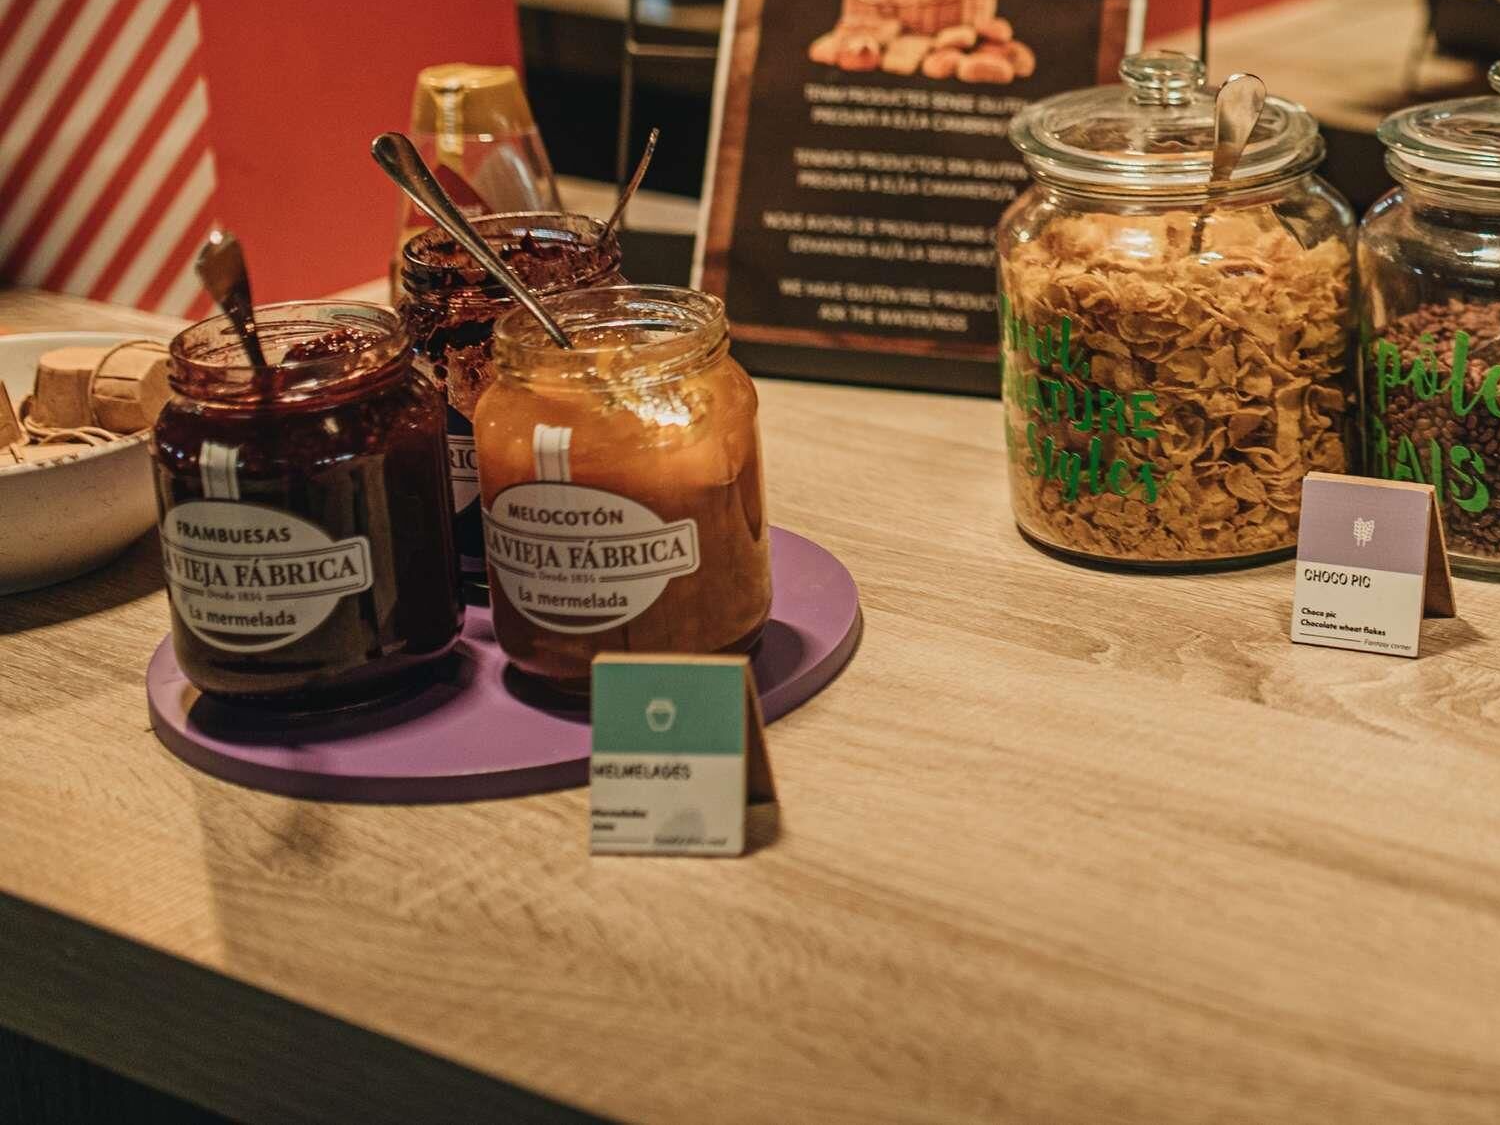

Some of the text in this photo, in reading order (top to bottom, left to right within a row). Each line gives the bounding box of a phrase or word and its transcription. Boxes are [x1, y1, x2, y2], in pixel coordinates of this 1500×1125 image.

[508, 503, 624, 527] MELOCOTÓN
[175, 520, 292, 545] FRAMBUESAS
[500, 536, 561, 570] VIEJA
[567, 537, 687, 570] FÁBRICA
[232, 554, 358, 588] FÁBRICA
[1304, 568, 1371, 588] CHOCO PIC
[518, 586, 628, 609] La mermelada
[189, 604, 297, 627] La mermelada
[1301, 607, 1324, 617] Choco
[1300, 618, 1386, 636] Chocolate wheat flakes
